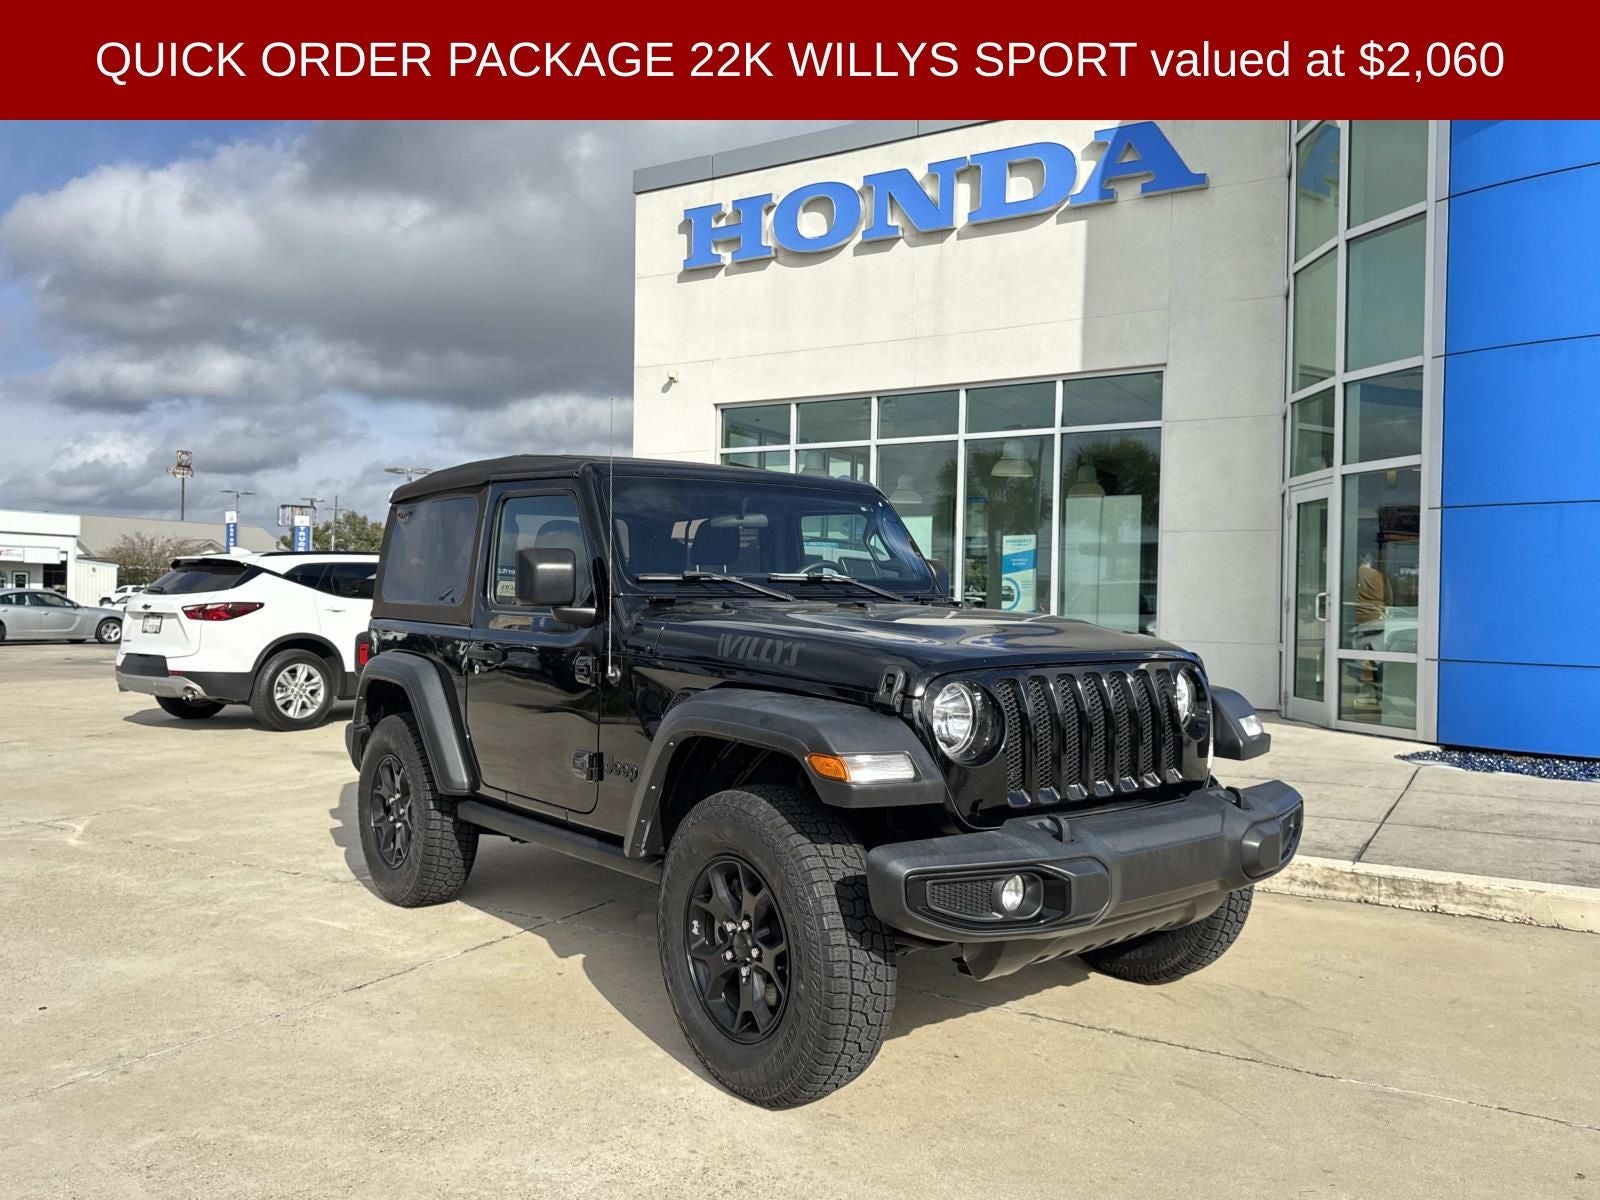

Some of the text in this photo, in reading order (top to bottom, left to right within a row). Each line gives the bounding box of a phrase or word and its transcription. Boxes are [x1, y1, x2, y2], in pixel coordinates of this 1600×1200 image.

[682, 121, 1208, 271] HONDA
[717, 632, 805, 666] WILLYS
[605, 755, 639, 783] Jeep
